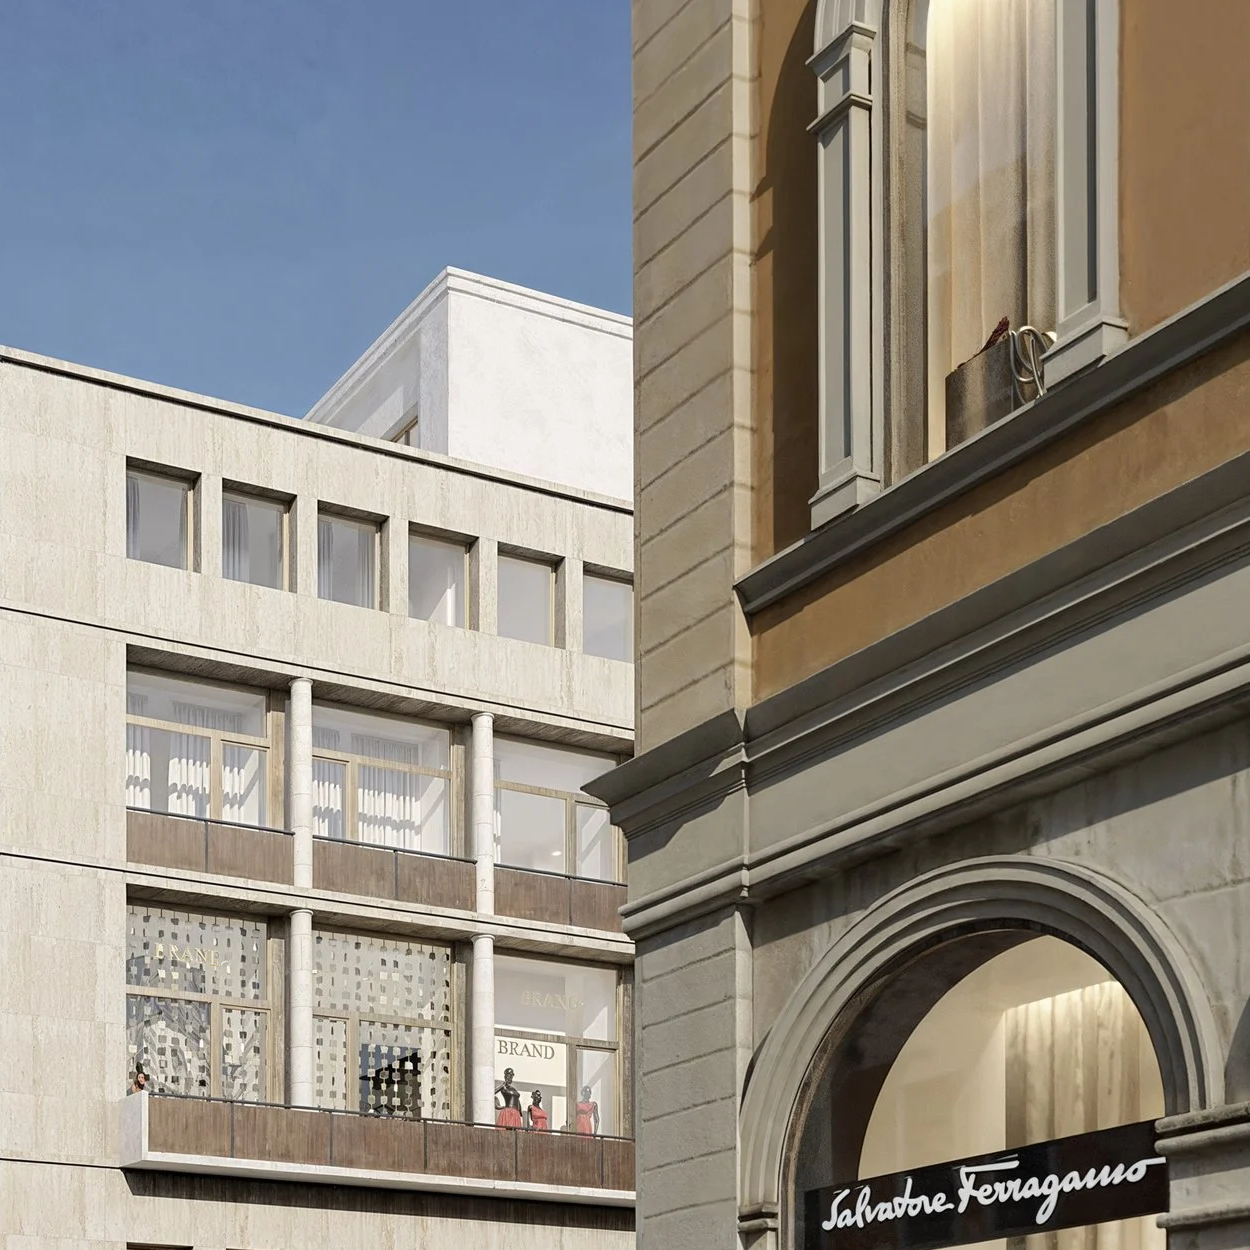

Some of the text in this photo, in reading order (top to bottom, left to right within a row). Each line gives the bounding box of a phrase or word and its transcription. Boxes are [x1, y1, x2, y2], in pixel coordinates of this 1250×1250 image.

[497, 1039, 555, 1060] BRAND
[822, 1156, 1167, 1231] Salvatore Ferragamo
